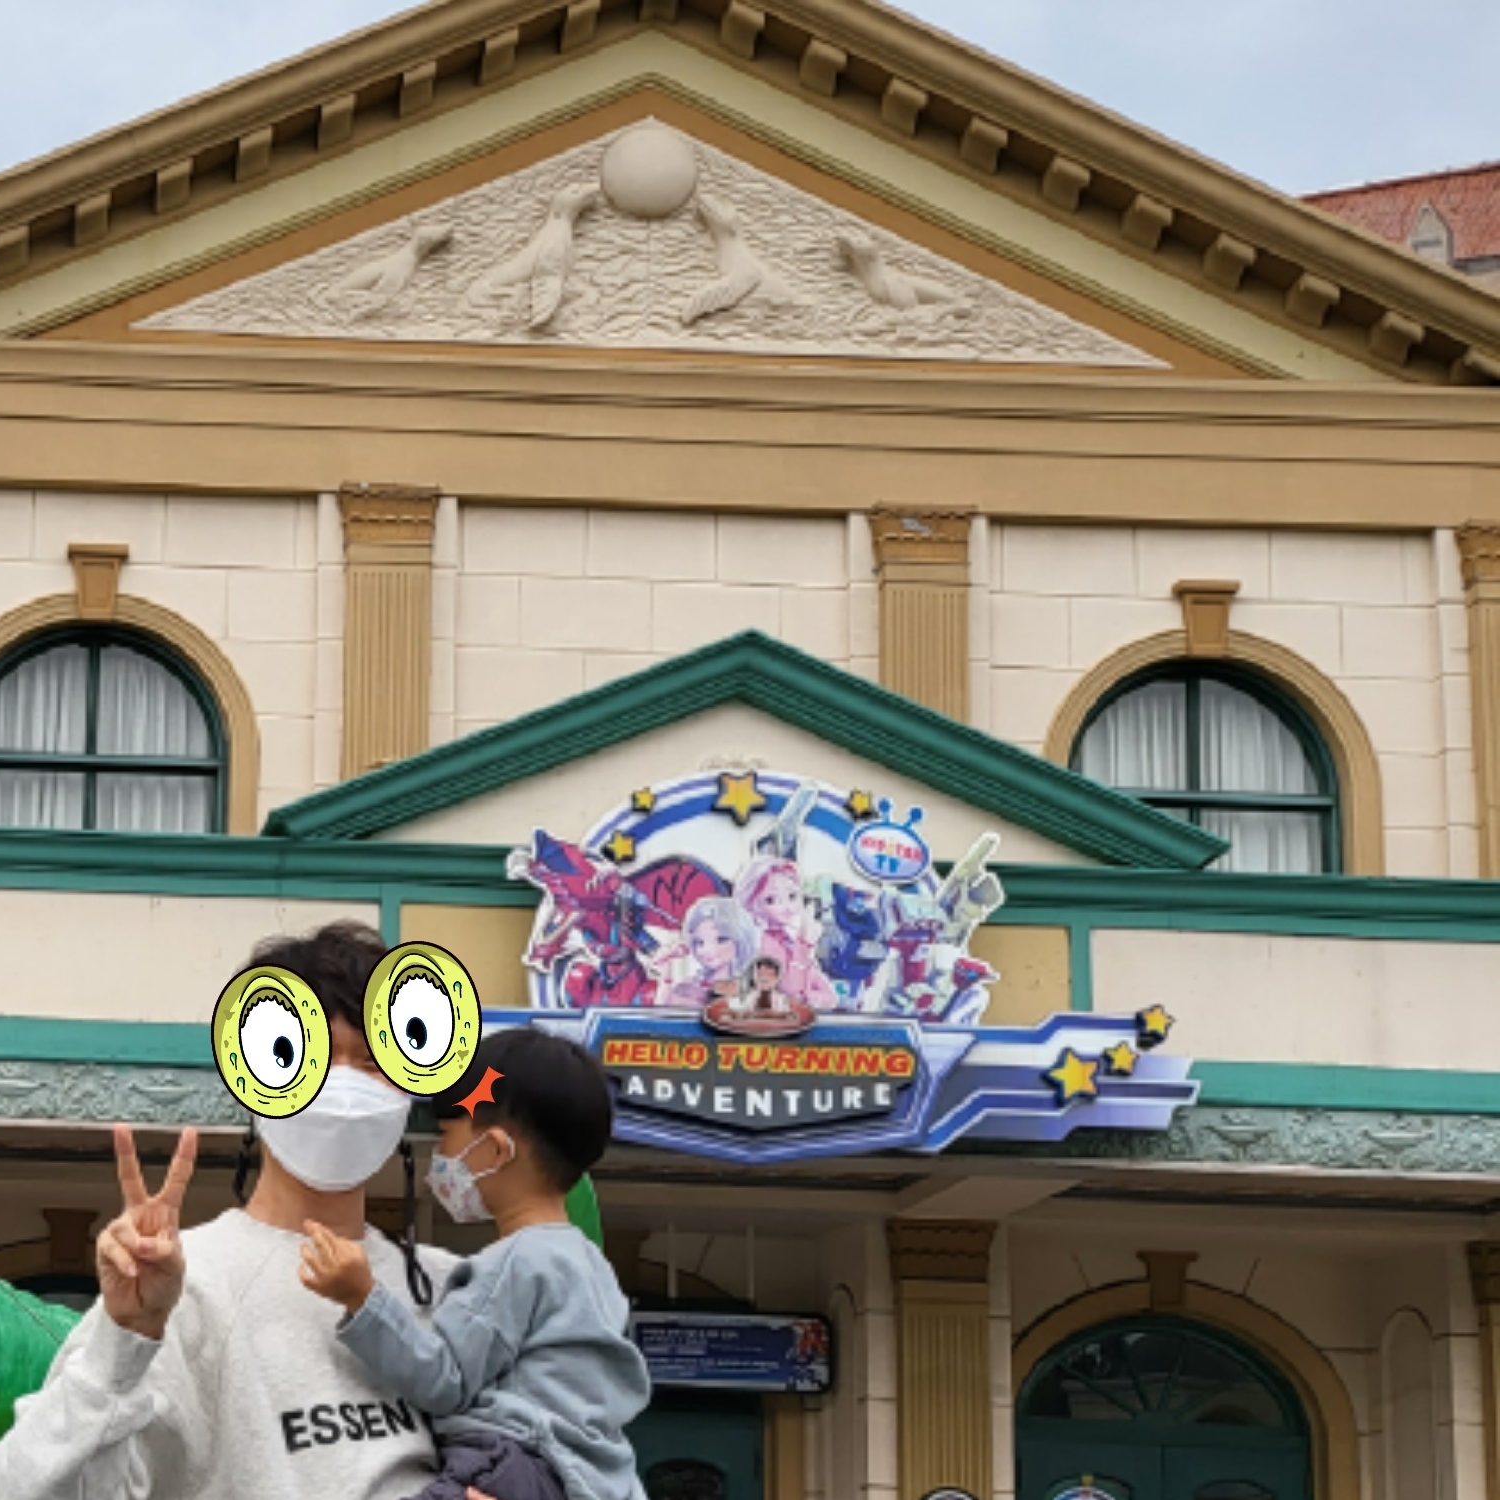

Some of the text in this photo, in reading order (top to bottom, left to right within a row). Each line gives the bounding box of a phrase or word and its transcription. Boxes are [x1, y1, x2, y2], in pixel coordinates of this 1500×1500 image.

[604, 1040, 915, 1076] HELLO TURNING
[625, 1075, 892, 1116] ADVENTURE
